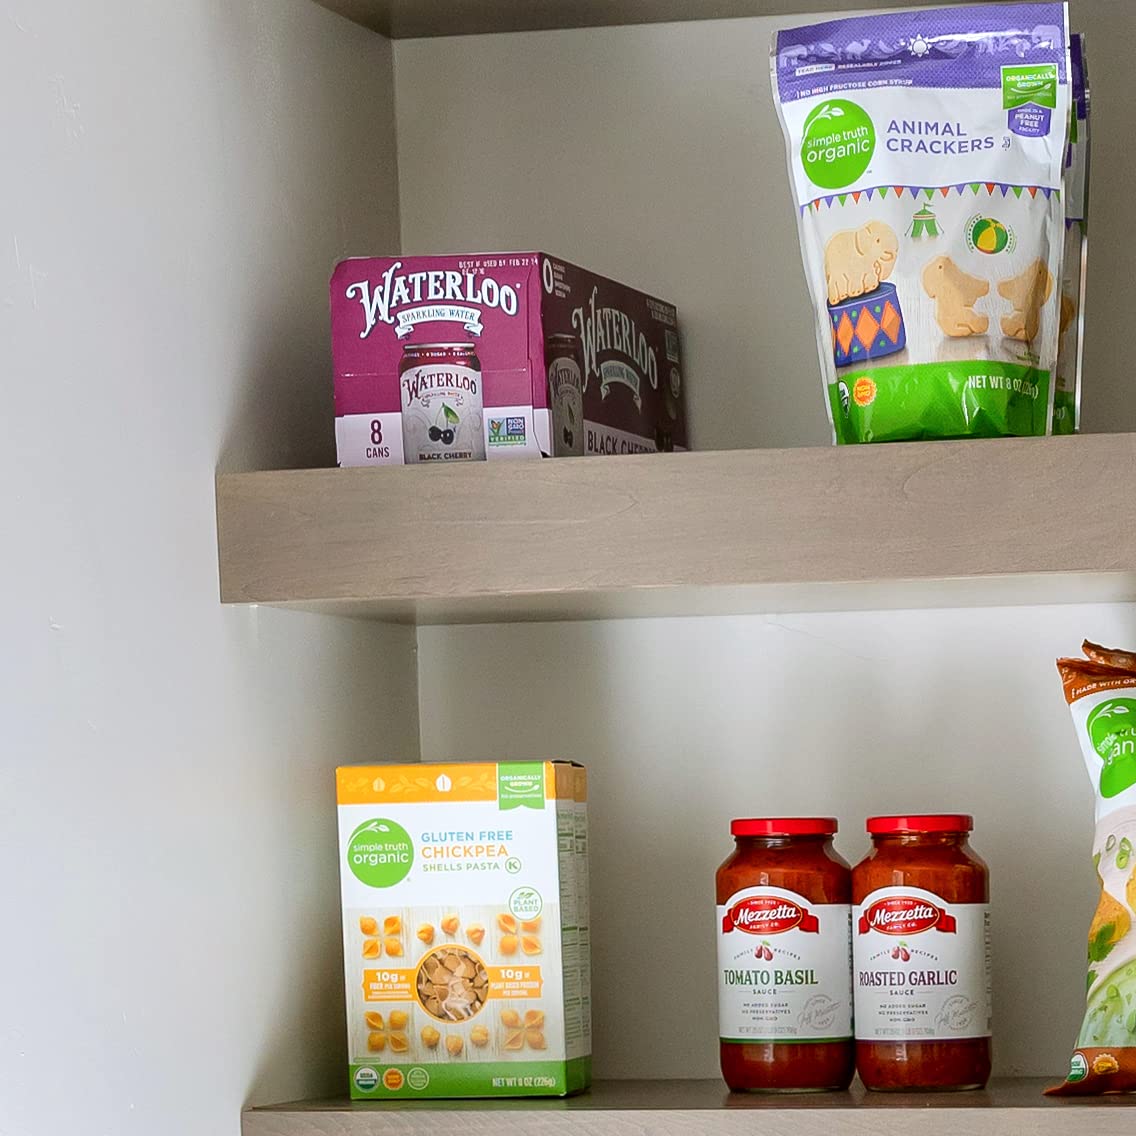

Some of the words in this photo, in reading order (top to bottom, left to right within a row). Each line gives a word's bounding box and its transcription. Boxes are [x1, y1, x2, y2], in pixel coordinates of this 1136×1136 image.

[812, 86, 829, 95] HIGH
[829, 82, 867, 92] FRUCTOSE
[868, 79, 888, 87] CORN
[1014, 113, 1045, 121] PEANUT
[886, 119, 967, 137] ANIMAL
[806, 131, 841, 150] simple
[842, 125, 869, 142] truth
[886, 136, 994, 154] CRACKERS
[806, 139, 870, 164] organic
[459, 261, 474, 269] BEST
[345, 261, 518, 339] WATERLOO
[401, 308, 446, 324] SPARKLING
[448, 308, 476, 321] WATER
[571, 285, 659, 394] WATERLOO
[402, 370, 477, 407] WATERLOO
[968, 375, 987, 389] NET
[989, 375, 1004, 389] WT
[1005, 378, 1012, 390] 8
[1013, 378, 1022, 392] OZ
[370, 420, 383, 444] 8
[588, 431, 618, 455] BLACK
[366, 447, 390, 458] CANS
[444, 452, 472, 460] CHERRY
[1076, 683, 1097, 695] MADE
[1100, 680, 1121, 688] WITH
[421, 832, 475, 843] GLUTEN
[479, 830, 513, 842] FREE
[353, 843, 384, 855] simple
[385, 842, 409, 851] truth
[421, 845, 509, 859] CHICKPEA
[353, 852, 409, 866] organic
[422, 863, 463, 872] SHELLS
[466, 862, 500, 871] PASTA
[513, 905, 539, 913] BASED
[733, 904, 797, 926] Mezzetta
[869, 904, 934, 927] Mezzetta
[773, 948, 801, 960] RECIPES
[911, 949, 938, 961] RECIPES
[375, 971, 399, 983] 10g
[500, 969, 523, 981] 10g
[723, 970, 770, 985] TOMATO
[774, 969, 819, 985] BASIL
[859, 971, 906, 986] ROASTED
[908, 970, 958, 986] GARLIC
